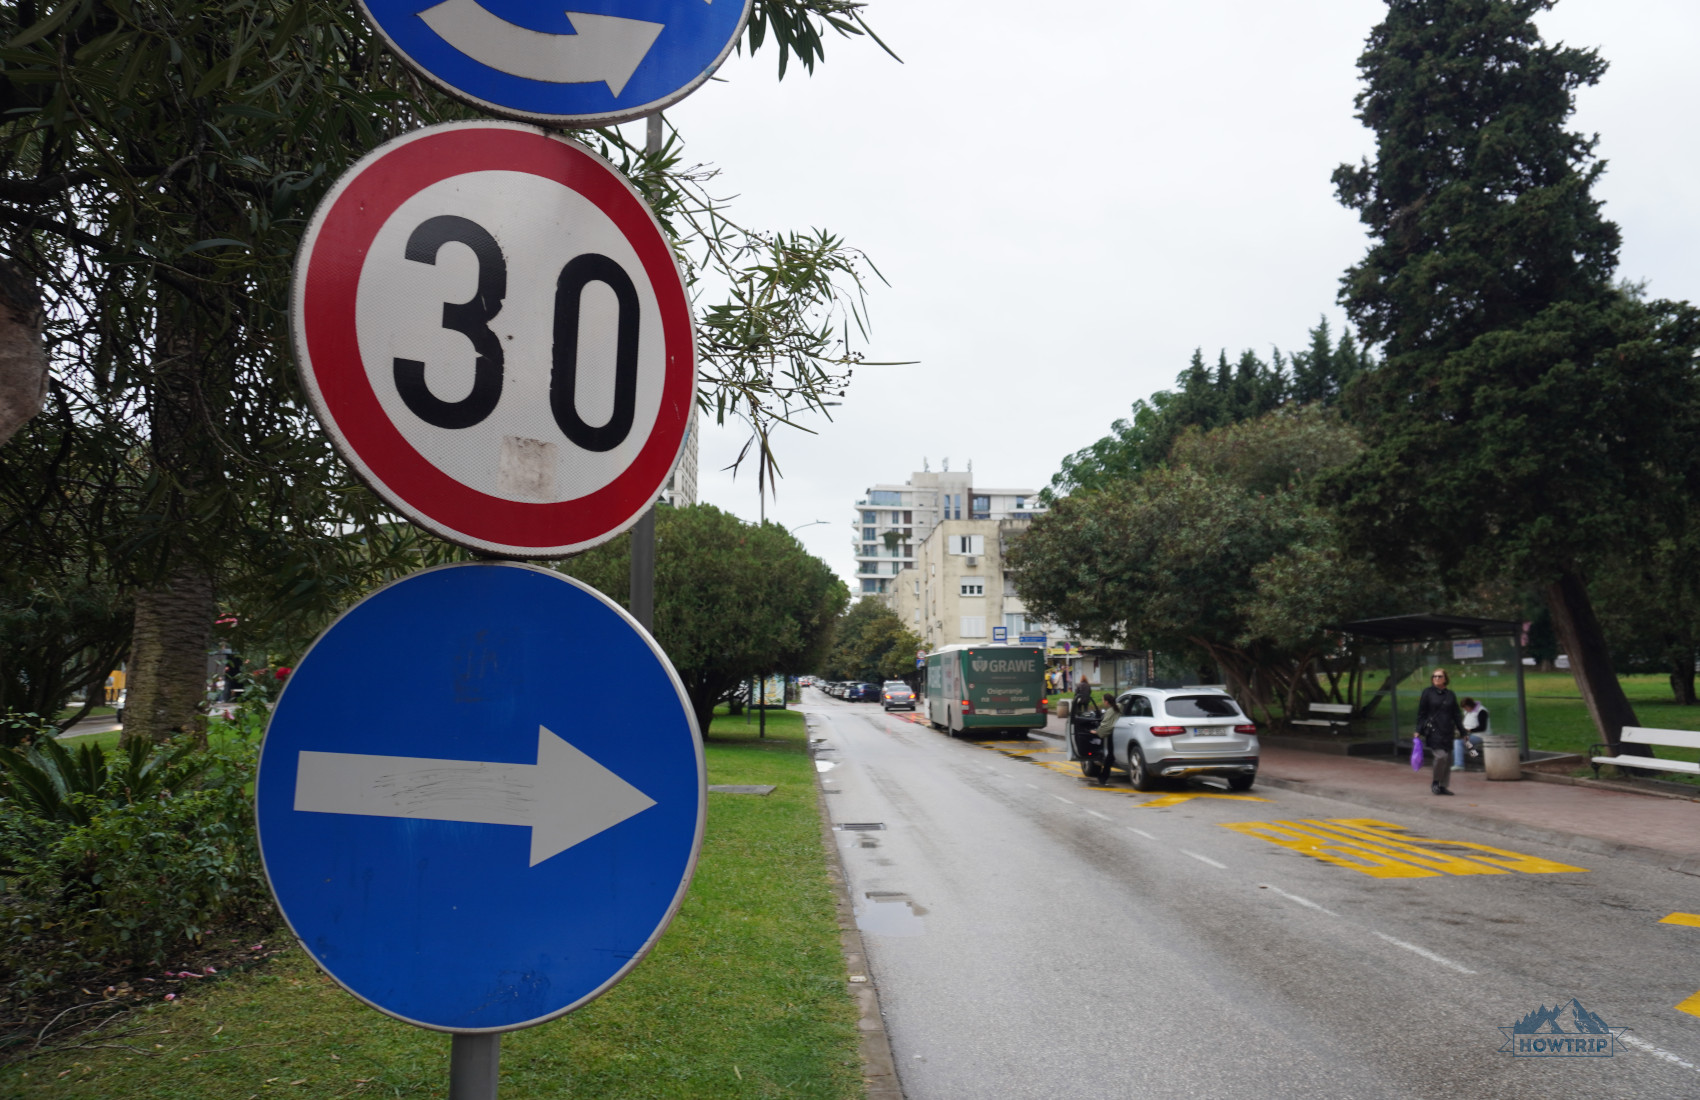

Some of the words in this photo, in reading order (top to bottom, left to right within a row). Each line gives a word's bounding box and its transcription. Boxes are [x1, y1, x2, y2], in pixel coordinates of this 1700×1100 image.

[393, 215, 640, 452] 30
[989, 659, 1036, 672] GRAWE
[987, 688, 1022, 696] Osiguranje
